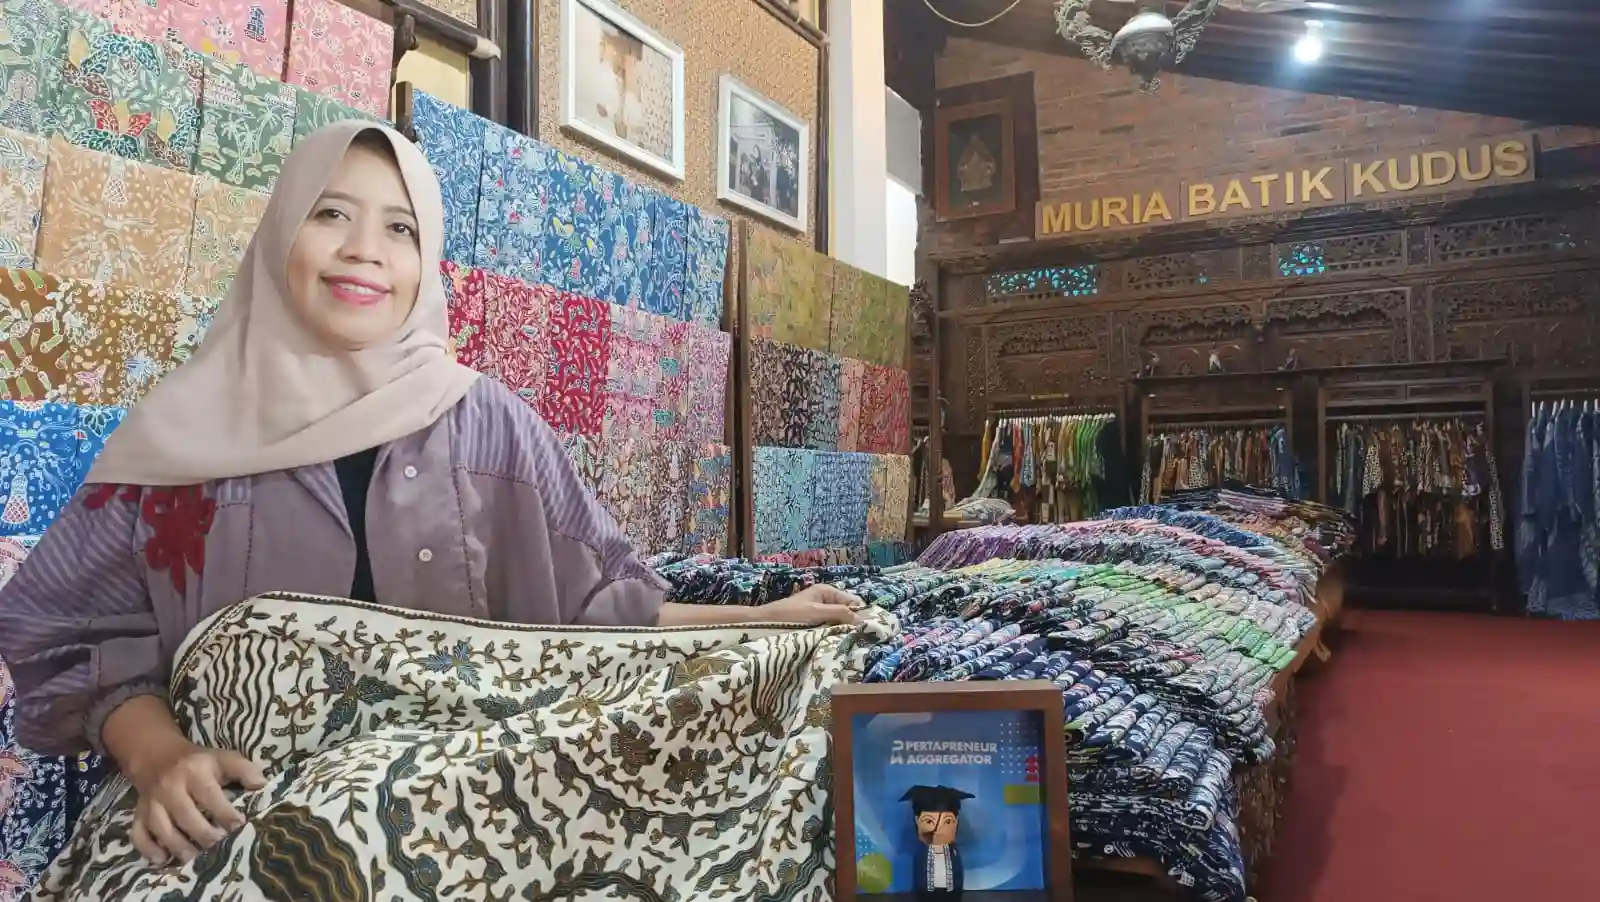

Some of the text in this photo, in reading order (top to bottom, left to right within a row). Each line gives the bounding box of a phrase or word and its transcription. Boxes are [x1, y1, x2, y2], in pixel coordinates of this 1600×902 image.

[1041, 140, 1529, 235] MURIA BATIK KUDUS
[905, 741, 998, 753] PERTAPRENEUR
[906, 754, 992, 765] AGGREGATOR
